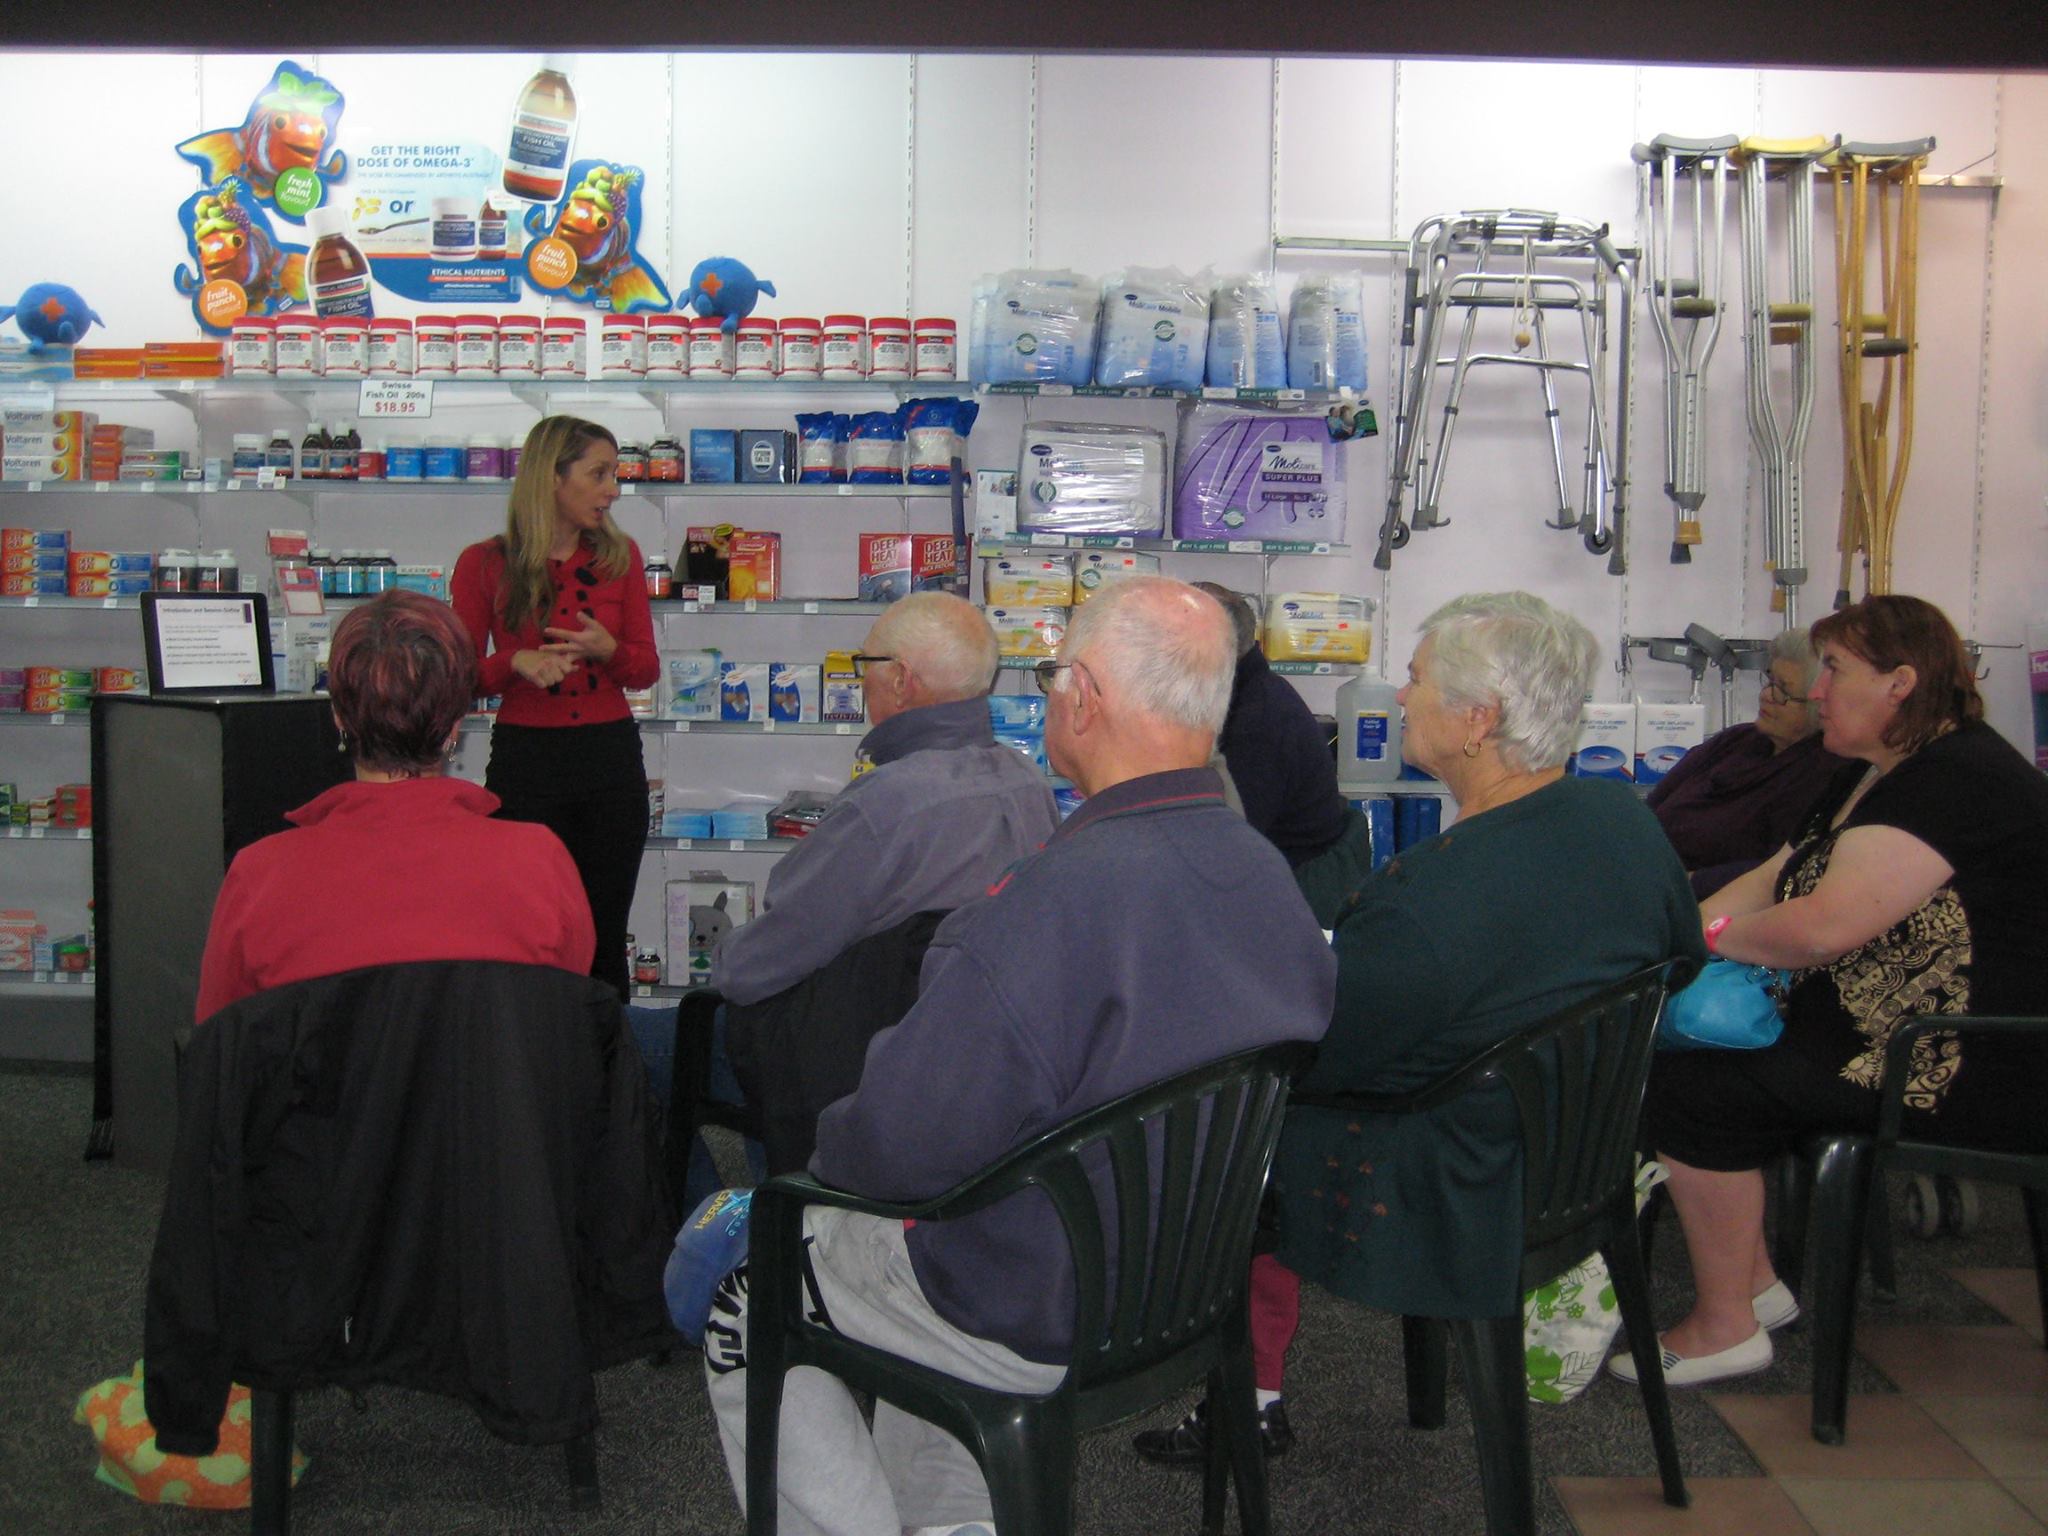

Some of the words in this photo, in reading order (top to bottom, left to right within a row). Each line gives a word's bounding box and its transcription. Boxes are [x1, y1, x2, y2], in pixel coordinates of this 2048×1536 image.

[371, 146, 393, 155] GET
[398, 146, 419, 155] THE
[424, 146, 460, 155] RIGHT
[357, 158, 389, 167] DOSE
[393, 158, 408, 167] OF
[288, 174, 312, 188] fresh
[287, 187, 310, 198] mint
[389, 200, 414, 213] or
[543, 244, 565, 259] fruit
[536, 254, 567, 269] punch
[432, 268, 462, 276] ETHICAL
[464, 268, 505, 276] NUTRIENTS
[207, 287, 228, 301] fruit
[207, 291, 236, 312] punch
[375, 402, 416, 413] $18.95
[5, 411, 43, 420] Voltaren
[6, 435, 42, 443] Voltaren
[4, 458, 41, 467] Voltaren
[872, 539, 899, 551] DEEP
[925, 540, 953, 553] DEEP
[872, 550, 898, 562] HEAT
[925, 550, 953, 563] HEAT
